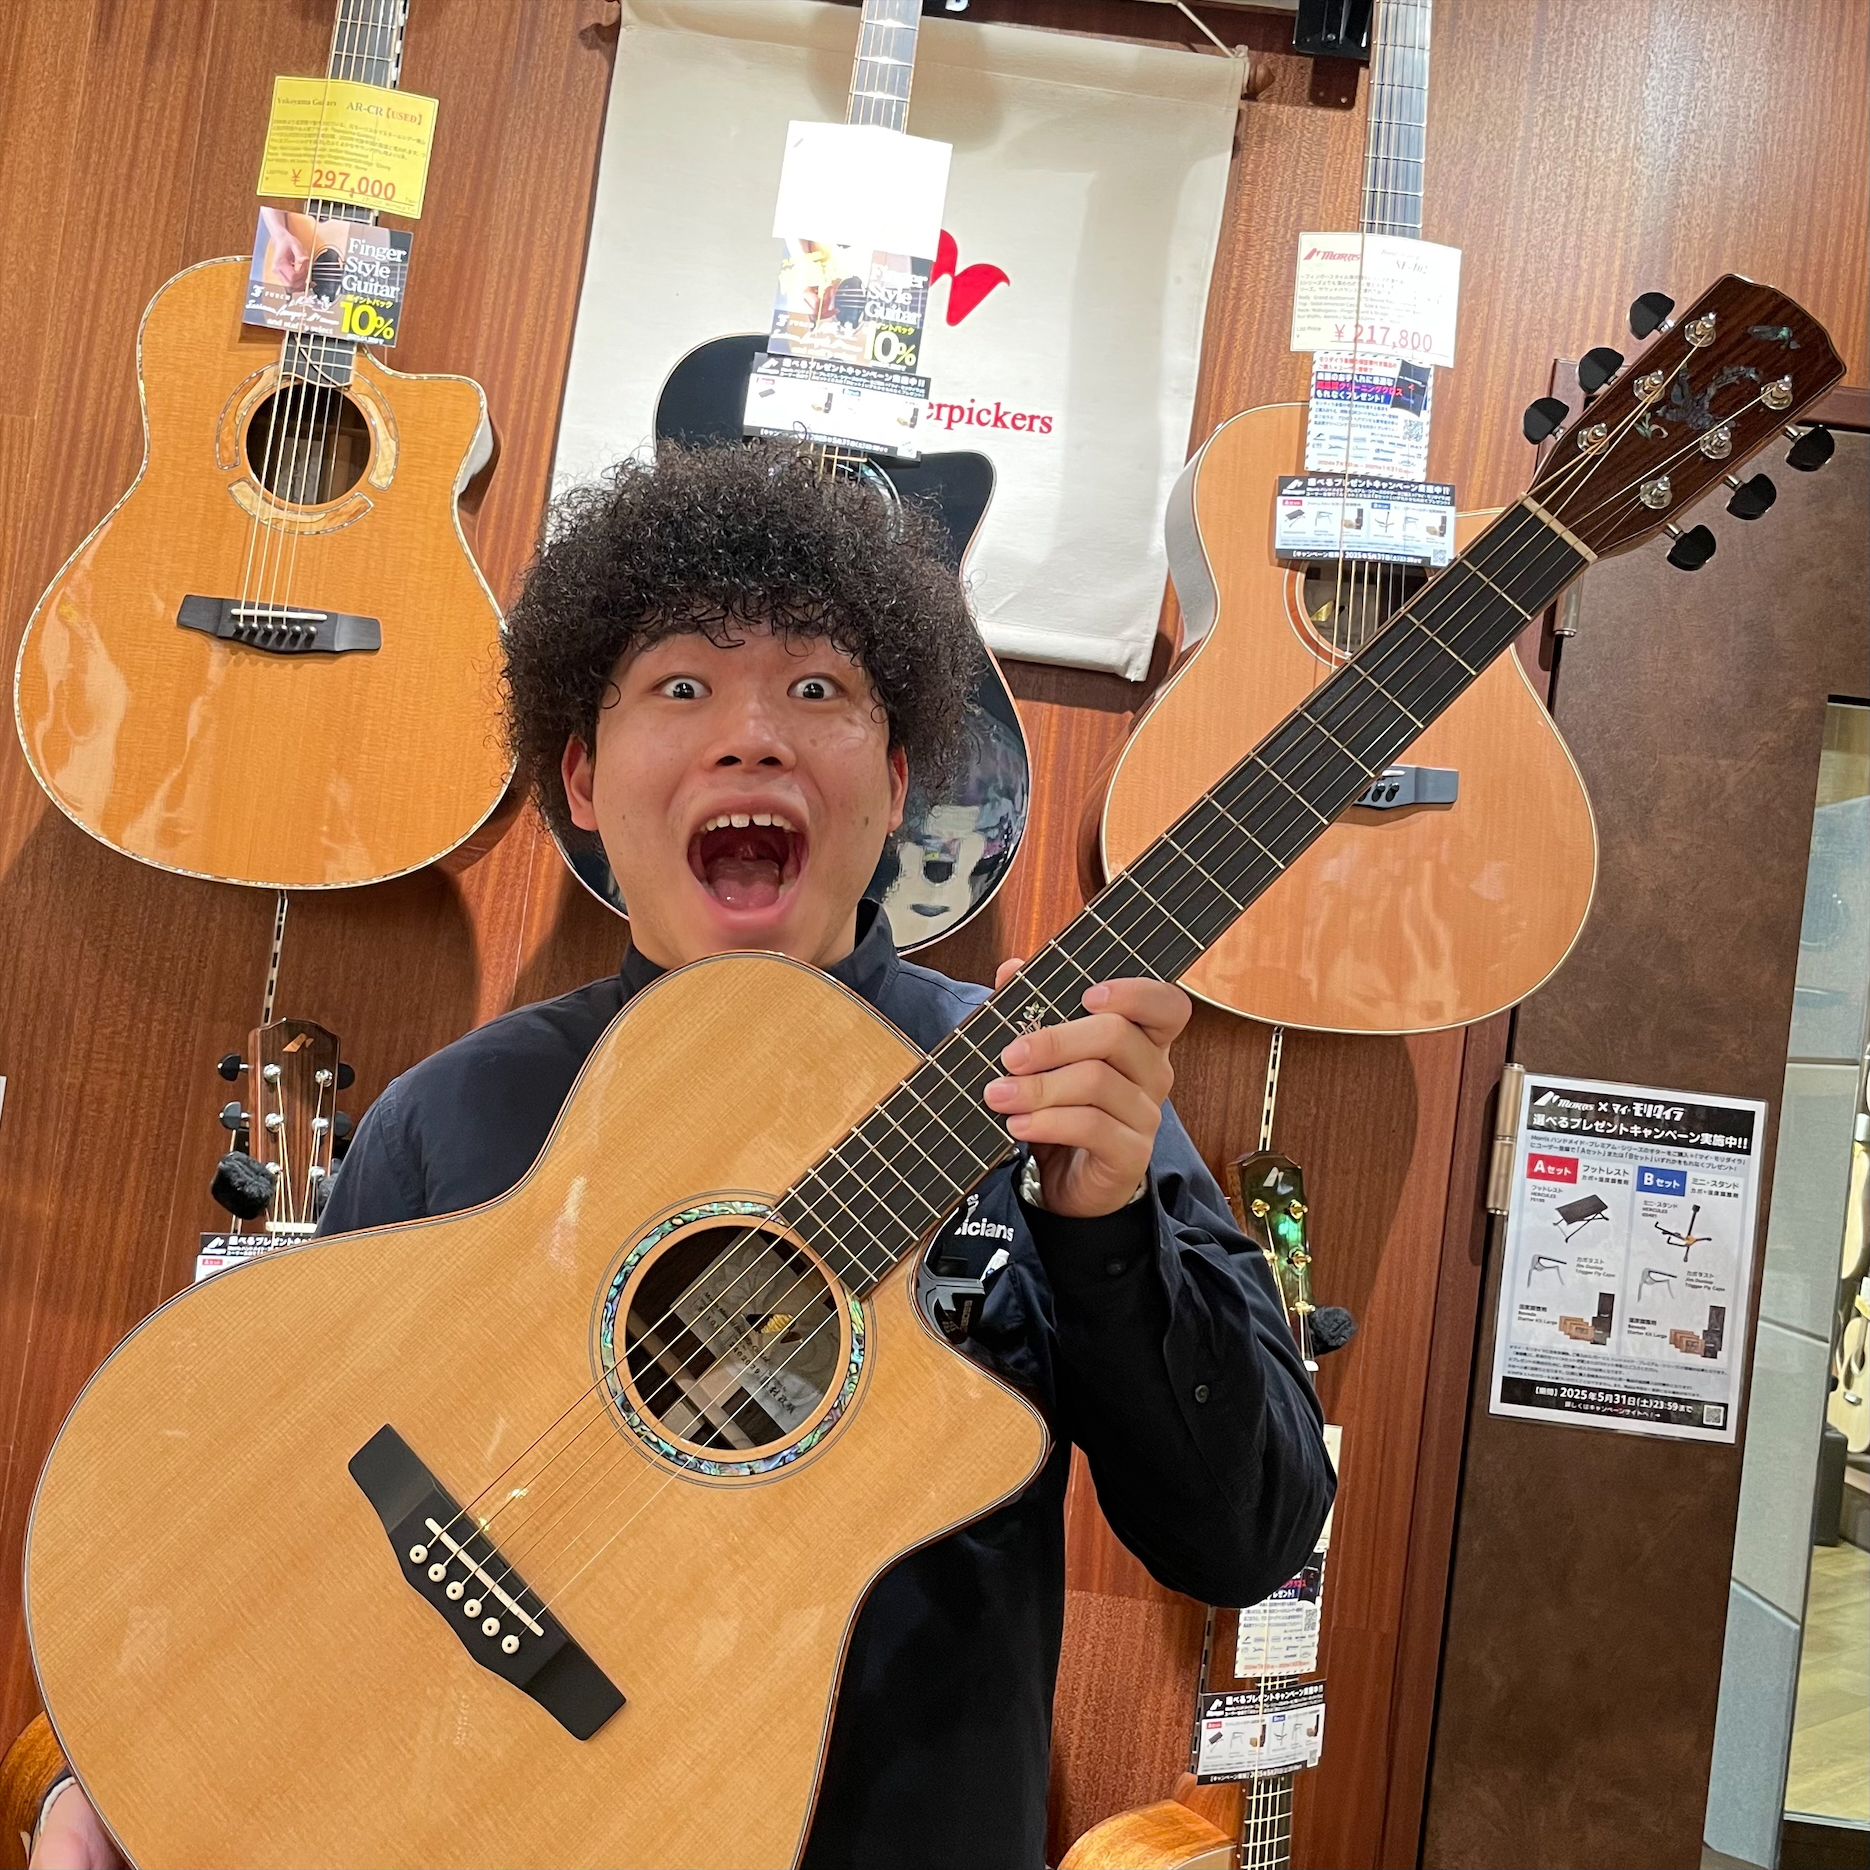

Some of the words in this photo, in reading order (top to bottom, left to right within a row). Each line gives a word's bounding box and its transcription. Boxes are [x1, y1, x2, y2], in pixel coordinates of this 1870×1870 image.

[312, 169, 396, 200] 297,000
[348, 238, 407, 262] Finger
[345, 256, 391, 279] Style
[342, 274, 401, 299] Guitar
[340, 302, 395, 340] 10%
[1353, 324, 1433, 352] 217,800
[1582, 1164, 1630, 1177] フットレスト
